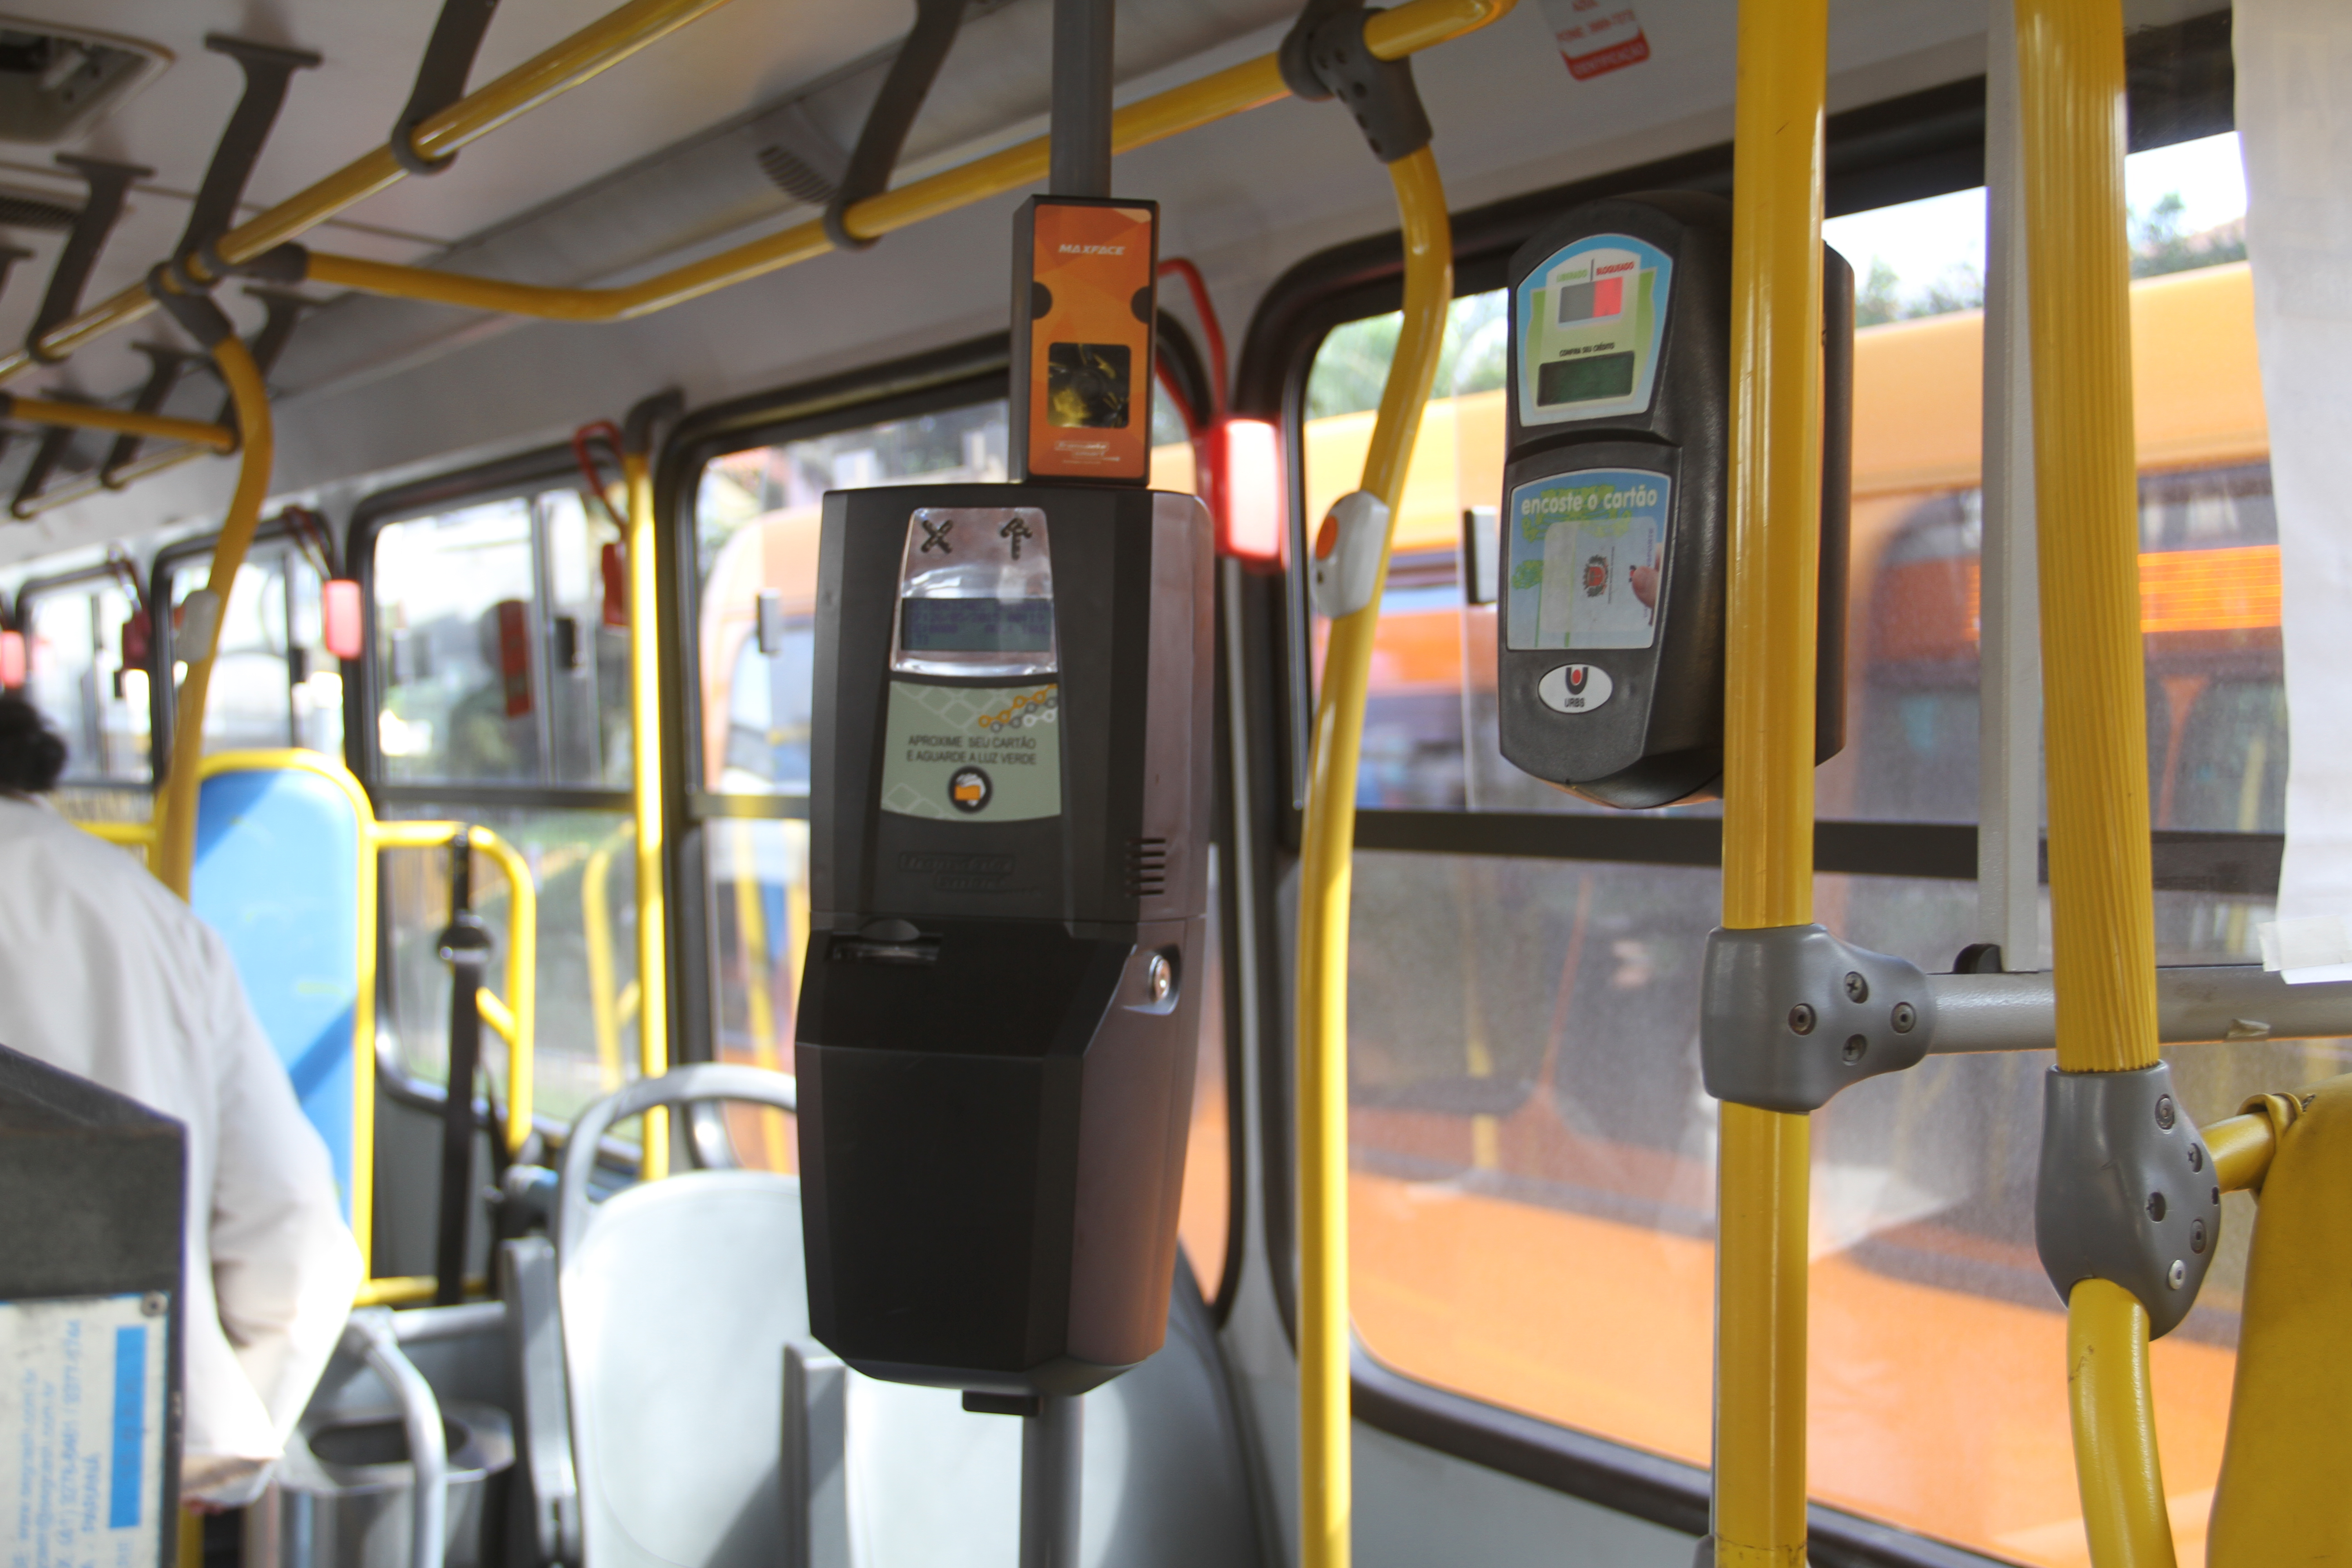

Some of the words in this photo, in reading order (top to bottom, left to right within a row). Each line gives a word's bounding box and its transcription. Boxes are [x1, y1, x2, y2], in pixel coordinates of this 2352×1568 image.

[1058, 244, 1125, 255] MAXFACE
[1597, 261, 1635, 275] BLOQUEADO
[1521, 492, 1583, 515] encoste
[1588, 493, 1598, 510] o
[1603, 484, 1657, 509] cartão
[1564, 698, 1585, 708] URBS
[908, 735, 962, 747] APROXIME
[968, 736, 990, 748] SEU
[992, 735, 1037, 749] CARTÃO
[907, 750, 914, 762] E
[916, 750, 966, 763] AGUARDE
[968, 751, 975, 763] A
[978, 752, 999, 764] LUZ
[1001, 752, 1037, 765] VERDE
